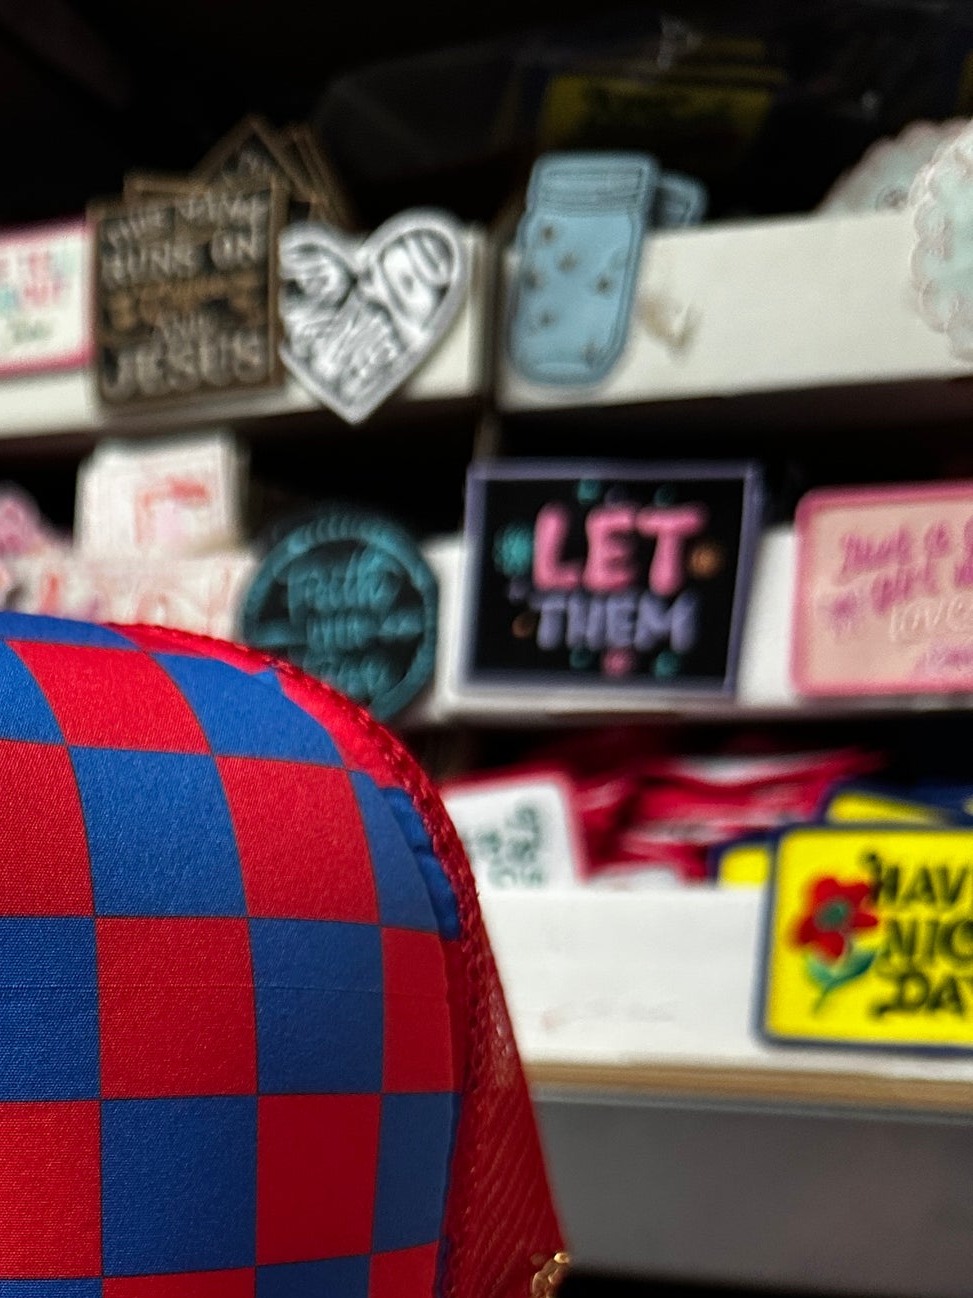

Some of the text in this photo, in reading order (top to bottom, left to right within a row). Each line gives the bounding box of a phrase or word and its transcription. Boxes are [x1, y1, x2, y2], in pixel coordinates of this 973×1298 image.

[532, 501, 707, 597] LET
[529, 590, 699, 653] THEM
[872, 970, 973, 1020] DA
